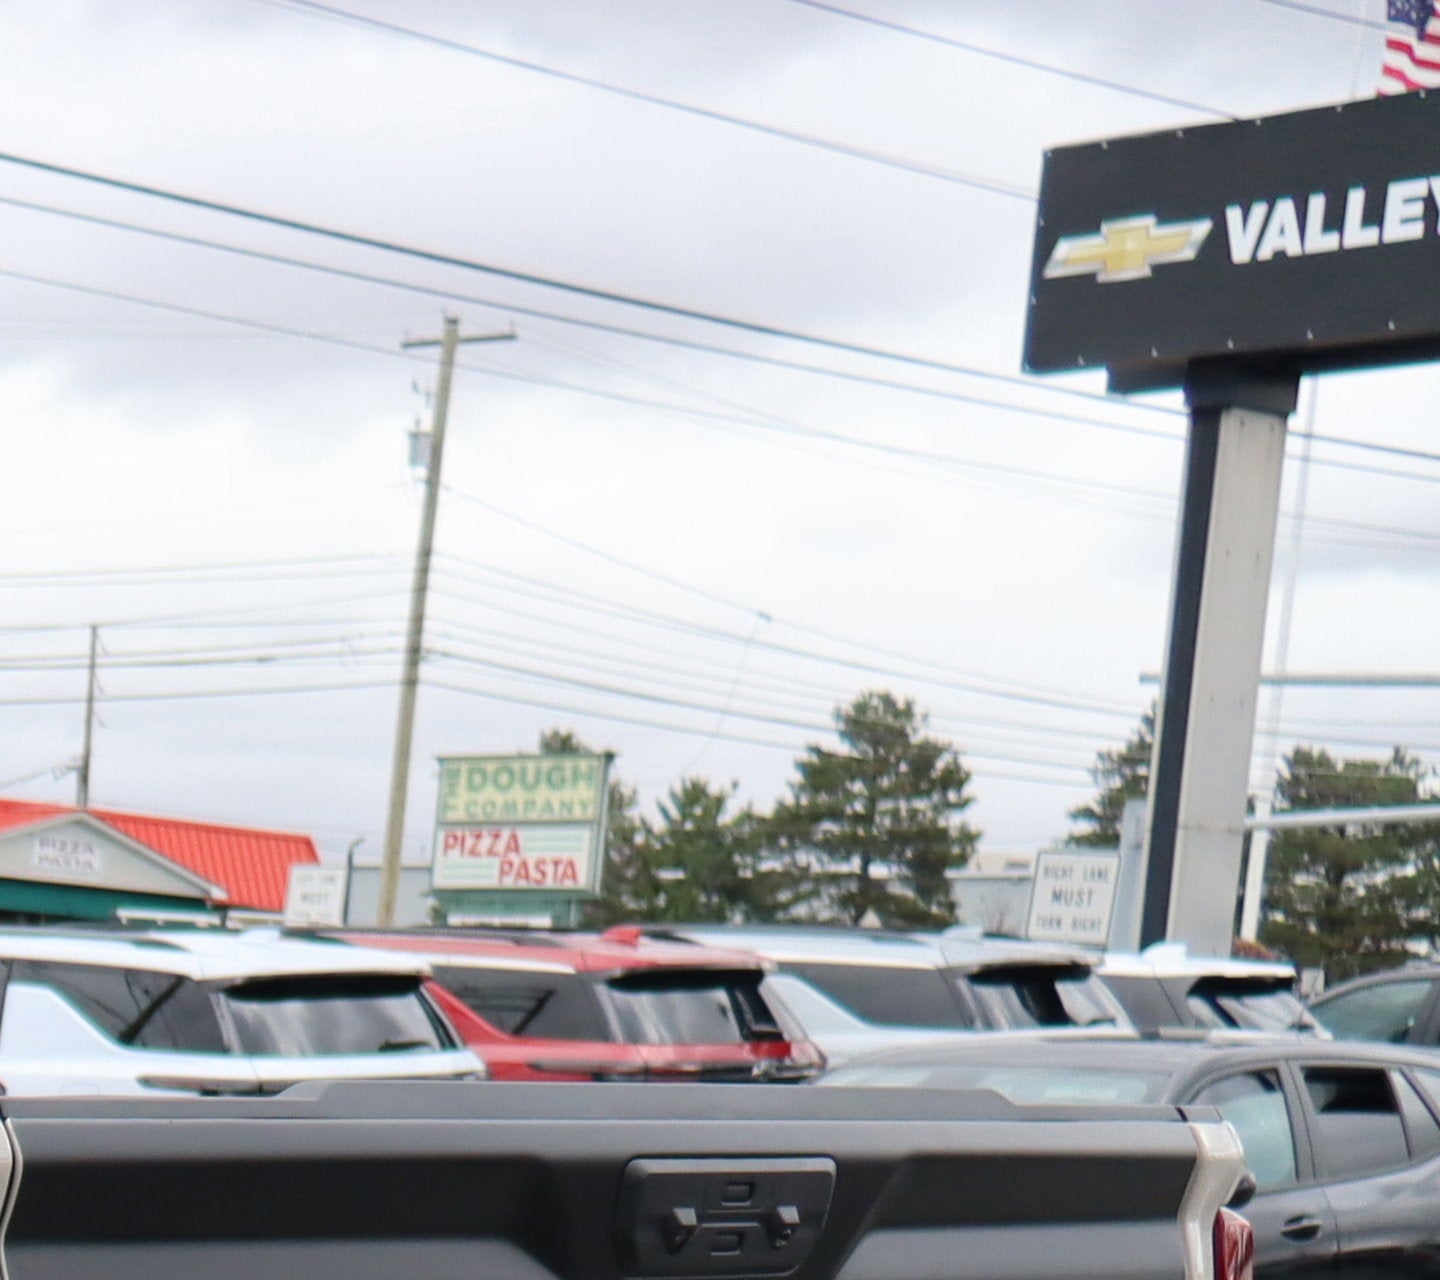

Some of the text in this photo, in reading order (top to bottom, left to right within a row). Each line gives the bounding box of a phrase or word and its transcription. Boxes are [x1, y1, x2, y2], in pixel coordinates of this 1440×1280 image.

[1225, 175, 1440, 265] VALLE
[467, 764, 594, 792] DOUGH
[465, 798, 594, 818] COMPANY
[443, 829, 521, 857] PIZZA
[499, 858, 579, 885] PASTA
[1050, 886, 1094, 908] MUST
